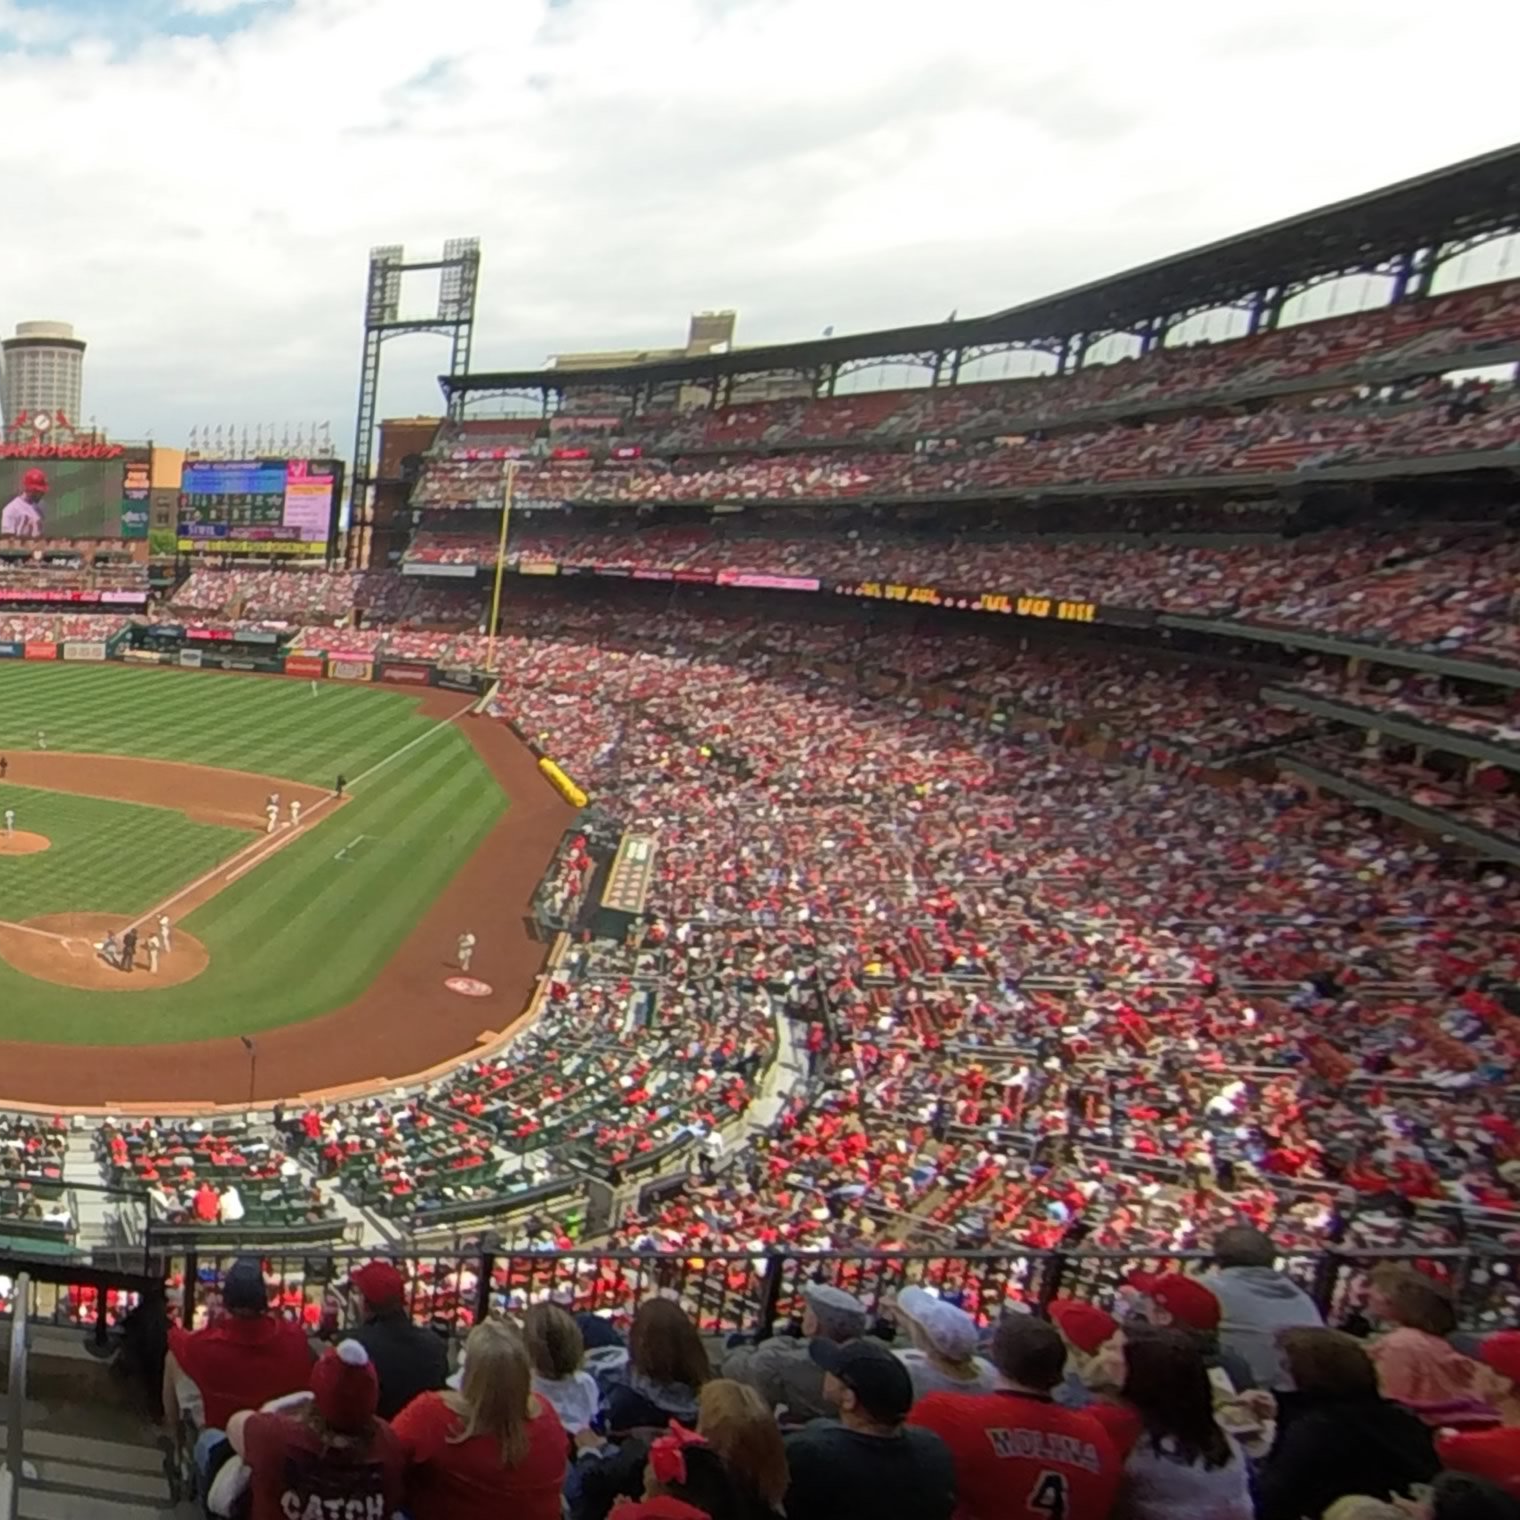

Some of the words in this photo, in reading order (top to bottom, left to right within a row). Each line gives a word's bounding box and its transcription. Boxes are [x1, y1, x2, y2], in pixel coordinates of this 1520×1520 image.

[984, 1427, 1101, 1475] MOLINA
[281, 1491, 384, 1520] CATCH
[1027, 1469, 1069, 1520] 4
